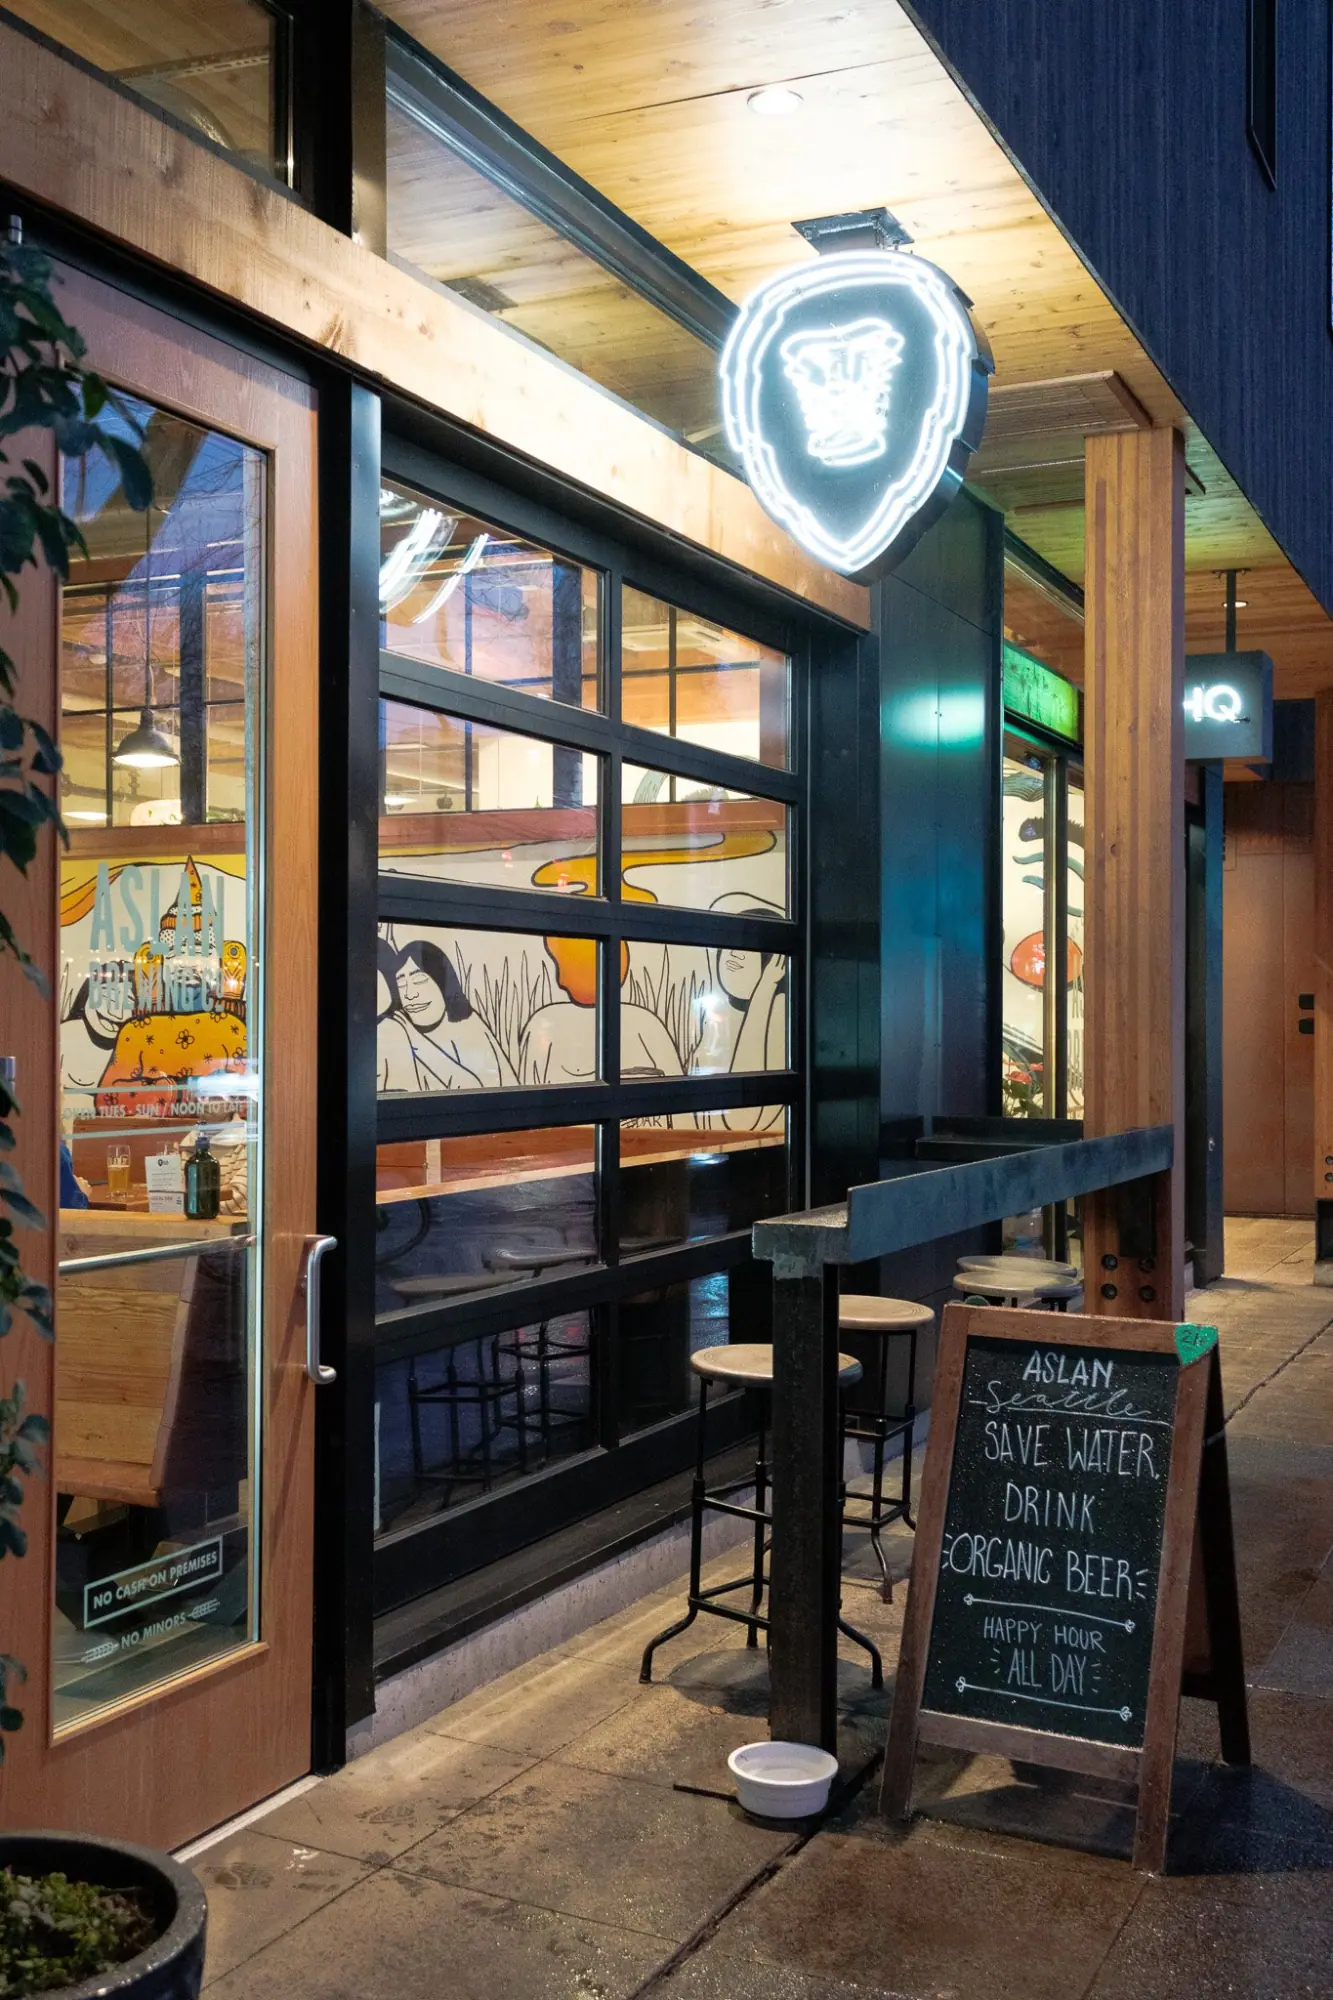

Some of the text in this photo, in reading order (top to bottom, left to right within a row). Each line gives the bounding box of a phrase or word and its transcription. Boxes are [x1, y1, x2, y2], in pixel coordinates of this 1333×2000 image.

[89, 862, 225, 957] ASLAN
[89, 961, 200, 1013] BREWING
[99, 1104, 126, 1118] TUES
[135, 1103, 160, 1117] SUN
[171, 1101, 205, 1116] NOON
[1022, 1350, 1114, 1388] ASLAN
[985, 1380, 1153, 1416] Seattle
[985, 1421, 1051, 1467] SAVE
[1004, 1482, 1095, 1534] DRINK
[93, 1551, 218, 1609] NO CASH ON PREMISES
[950, 1532, 1132, 1600] ORGANIC BEER
[121, 1612, 187, 1650] NO MINORS
[983, 1616, 1107, 1653] HAPPY HOUR
[1007, 1648, 1087, 1696] ALL DAY
